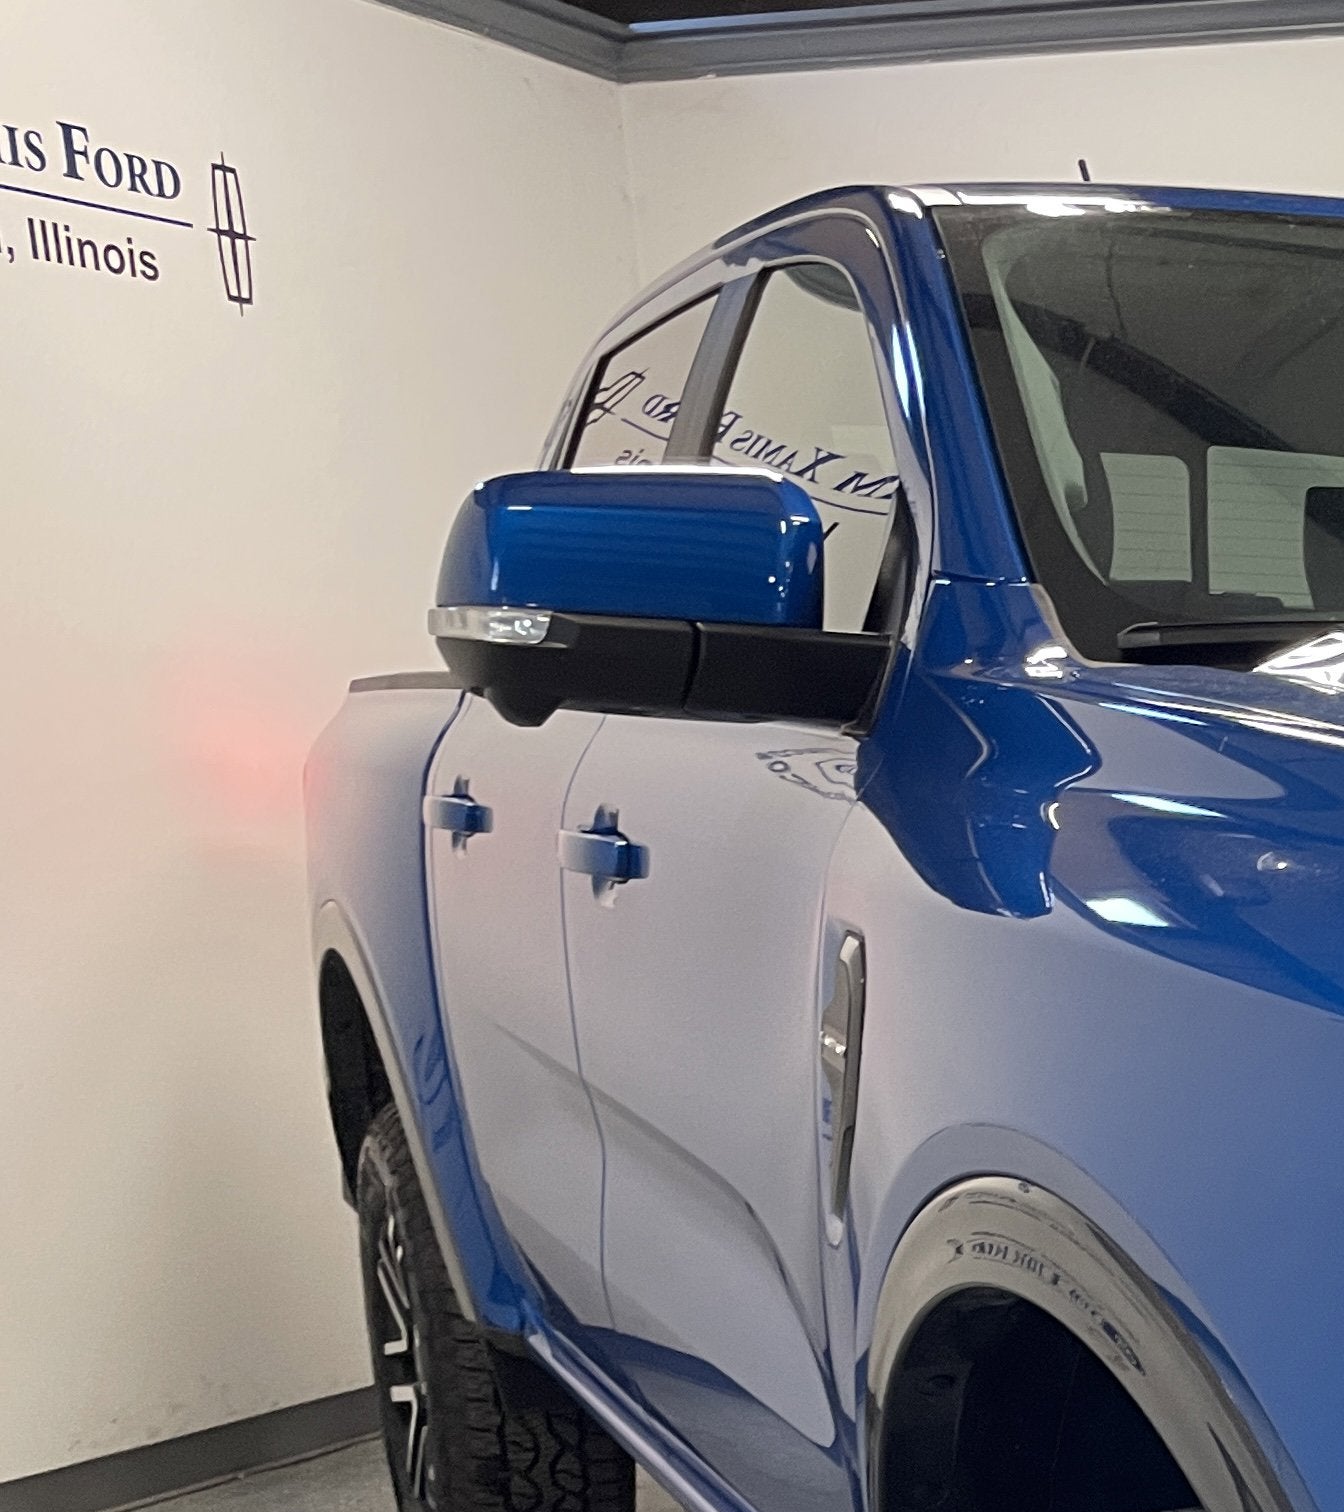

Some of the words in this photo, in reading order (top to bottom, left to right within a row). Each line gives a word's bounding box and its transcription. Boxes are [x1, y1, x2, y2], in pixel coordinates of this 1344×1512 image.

[0, 124, 46, 172] IS
[56, 120, 181, 200] FORD
[27, 217, 160, 281] Illinois
